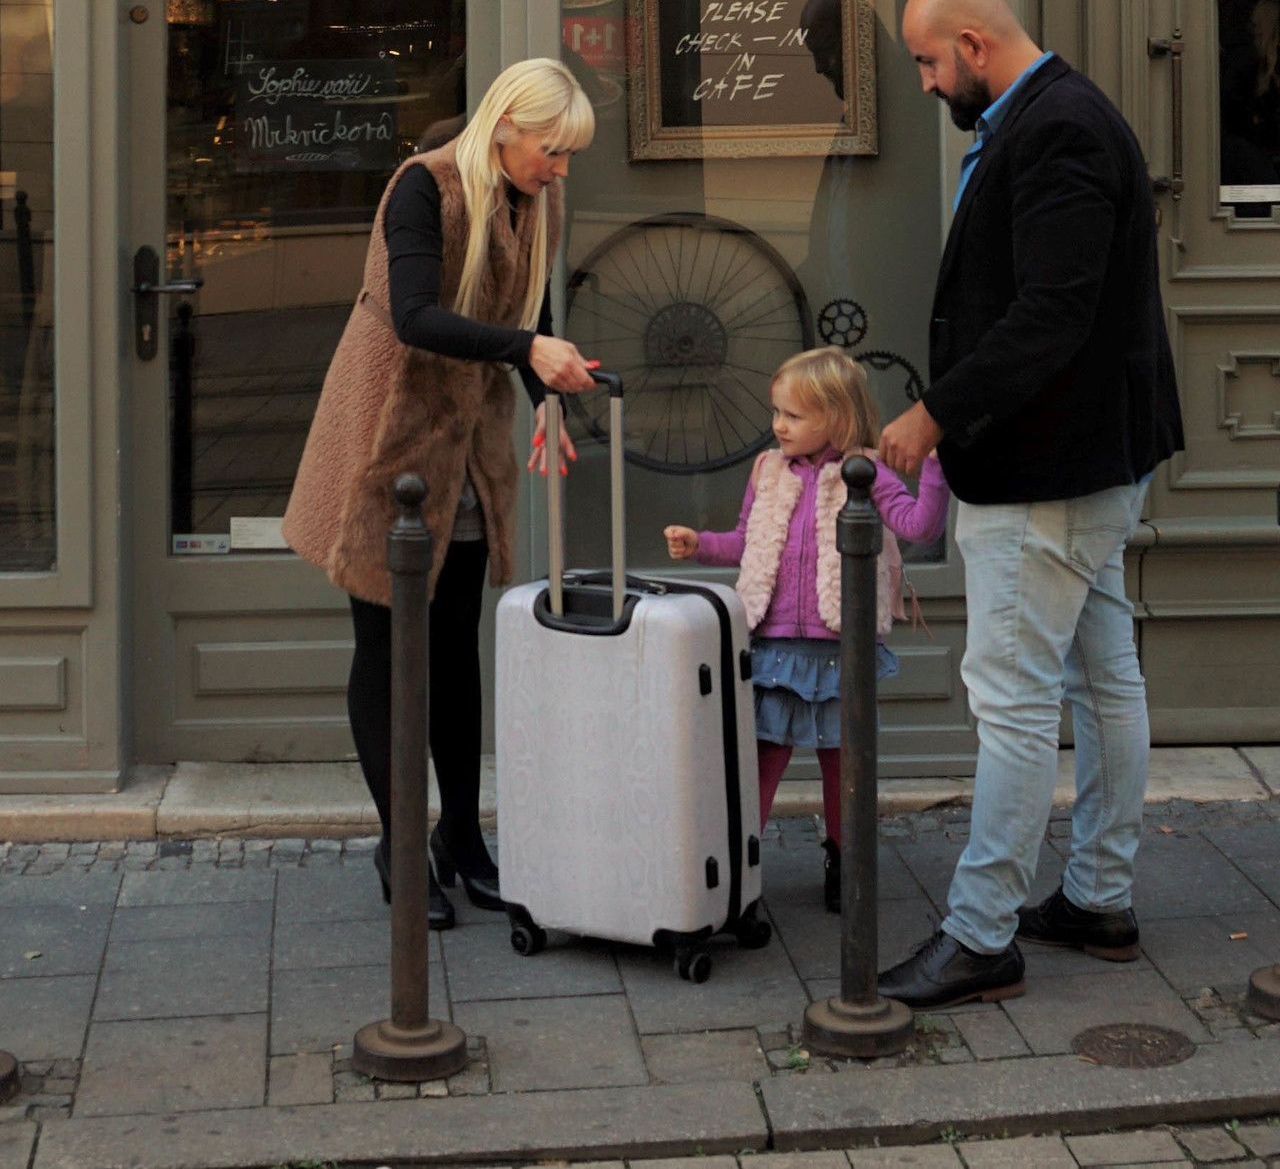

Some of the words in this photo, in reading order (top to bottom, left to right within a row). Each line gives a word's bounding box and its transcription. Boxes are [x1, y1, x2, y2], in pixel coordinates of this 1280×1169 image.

[701, 1, 788, 24] PLEASE
[726, 52, 756, 75] IN
[693, 73, 785, 101] CAFE
